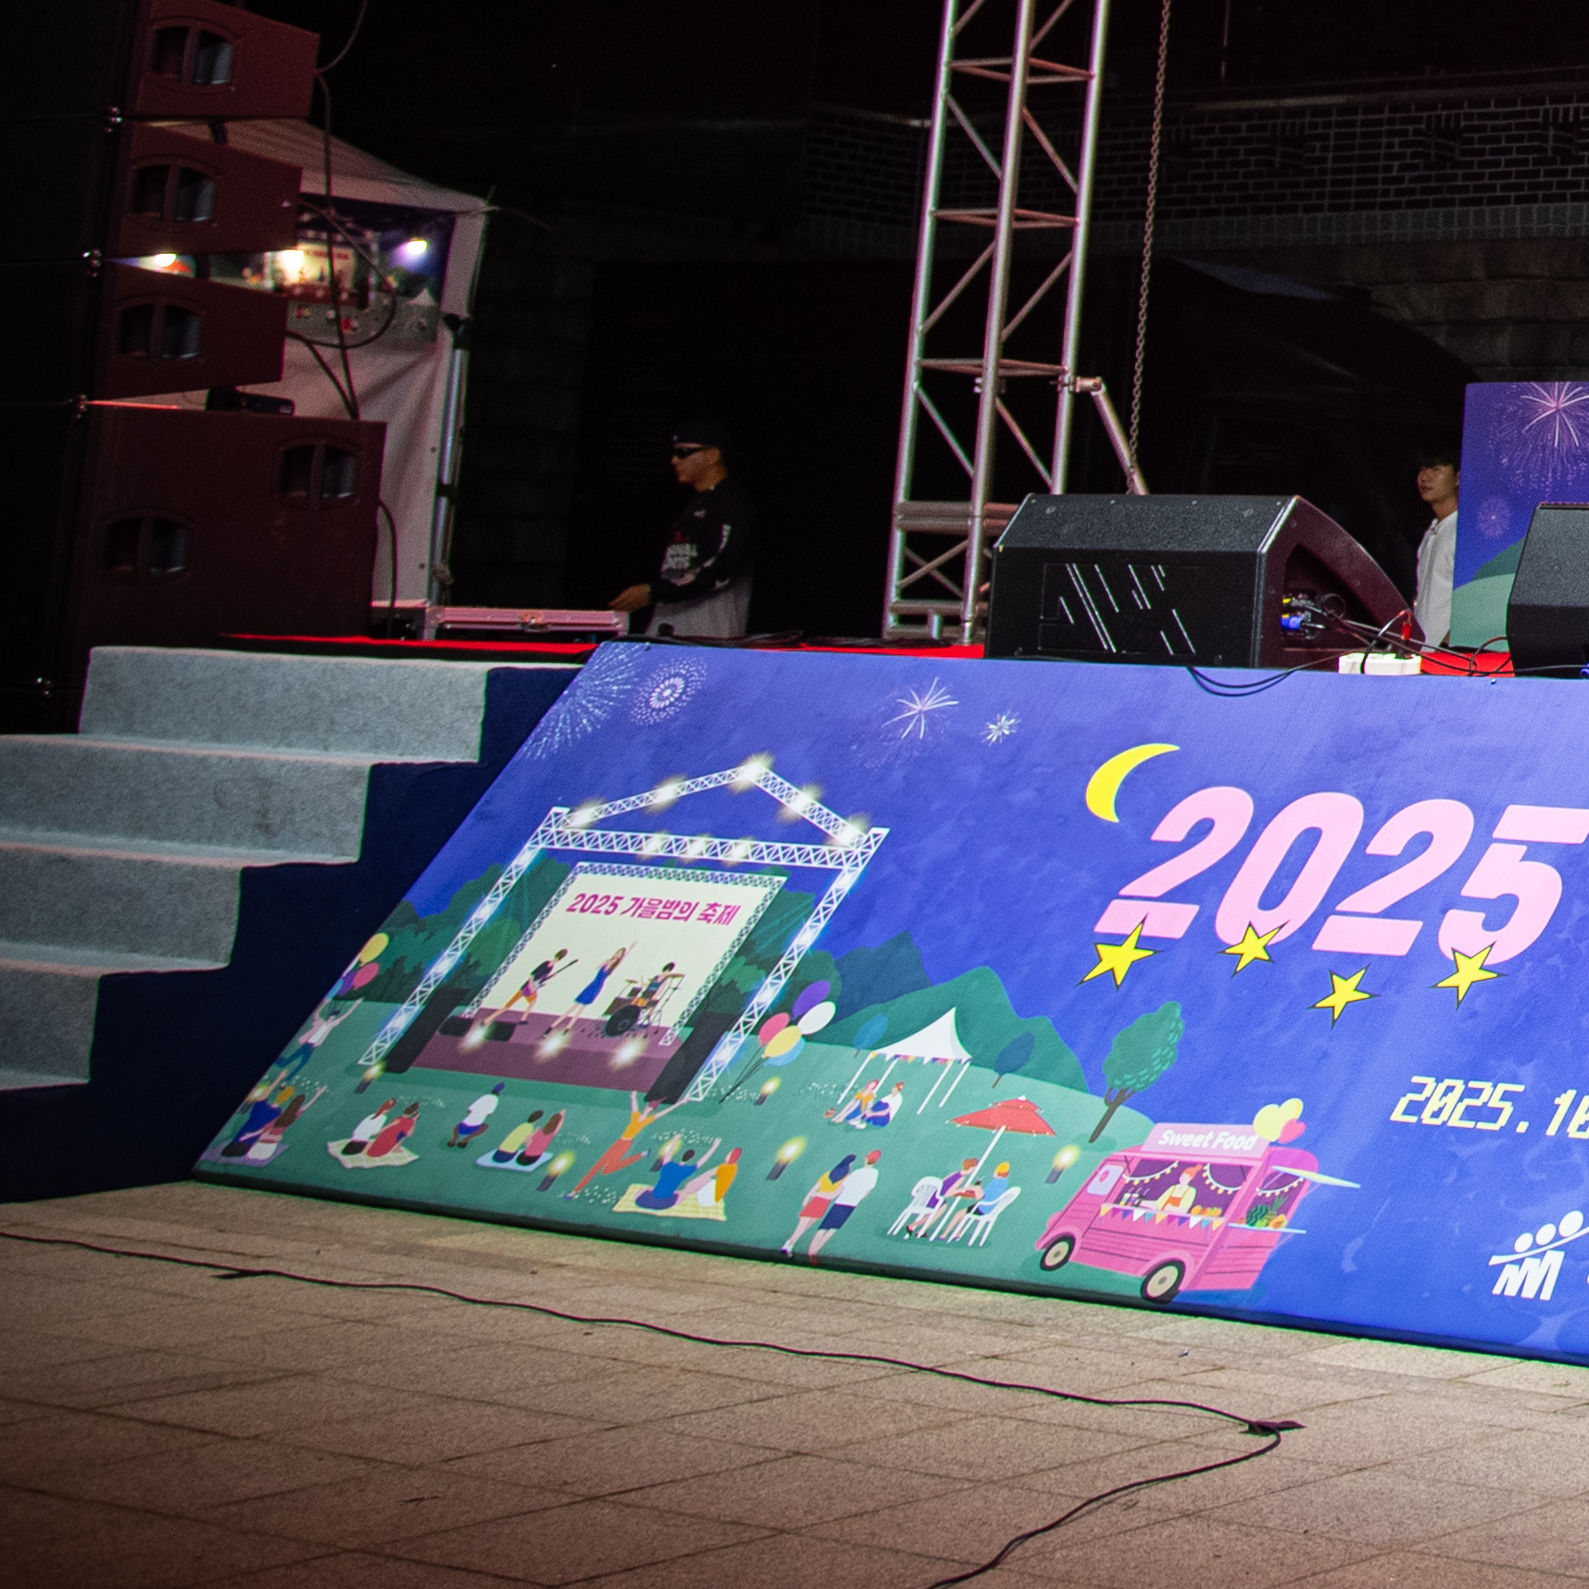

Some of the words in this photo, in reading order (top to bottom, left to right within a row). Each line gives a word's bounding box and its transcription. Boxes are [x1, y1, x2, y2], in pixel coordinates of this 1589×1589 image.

[566, 892, 621, 916] 2025
[621, 896, 697, 922] 가을밤의
[697, 901, 742, 926] 축제
[1158, 1130, 1215, 1149] Sweet
[1212, 1131, 1260, 1151] Food
